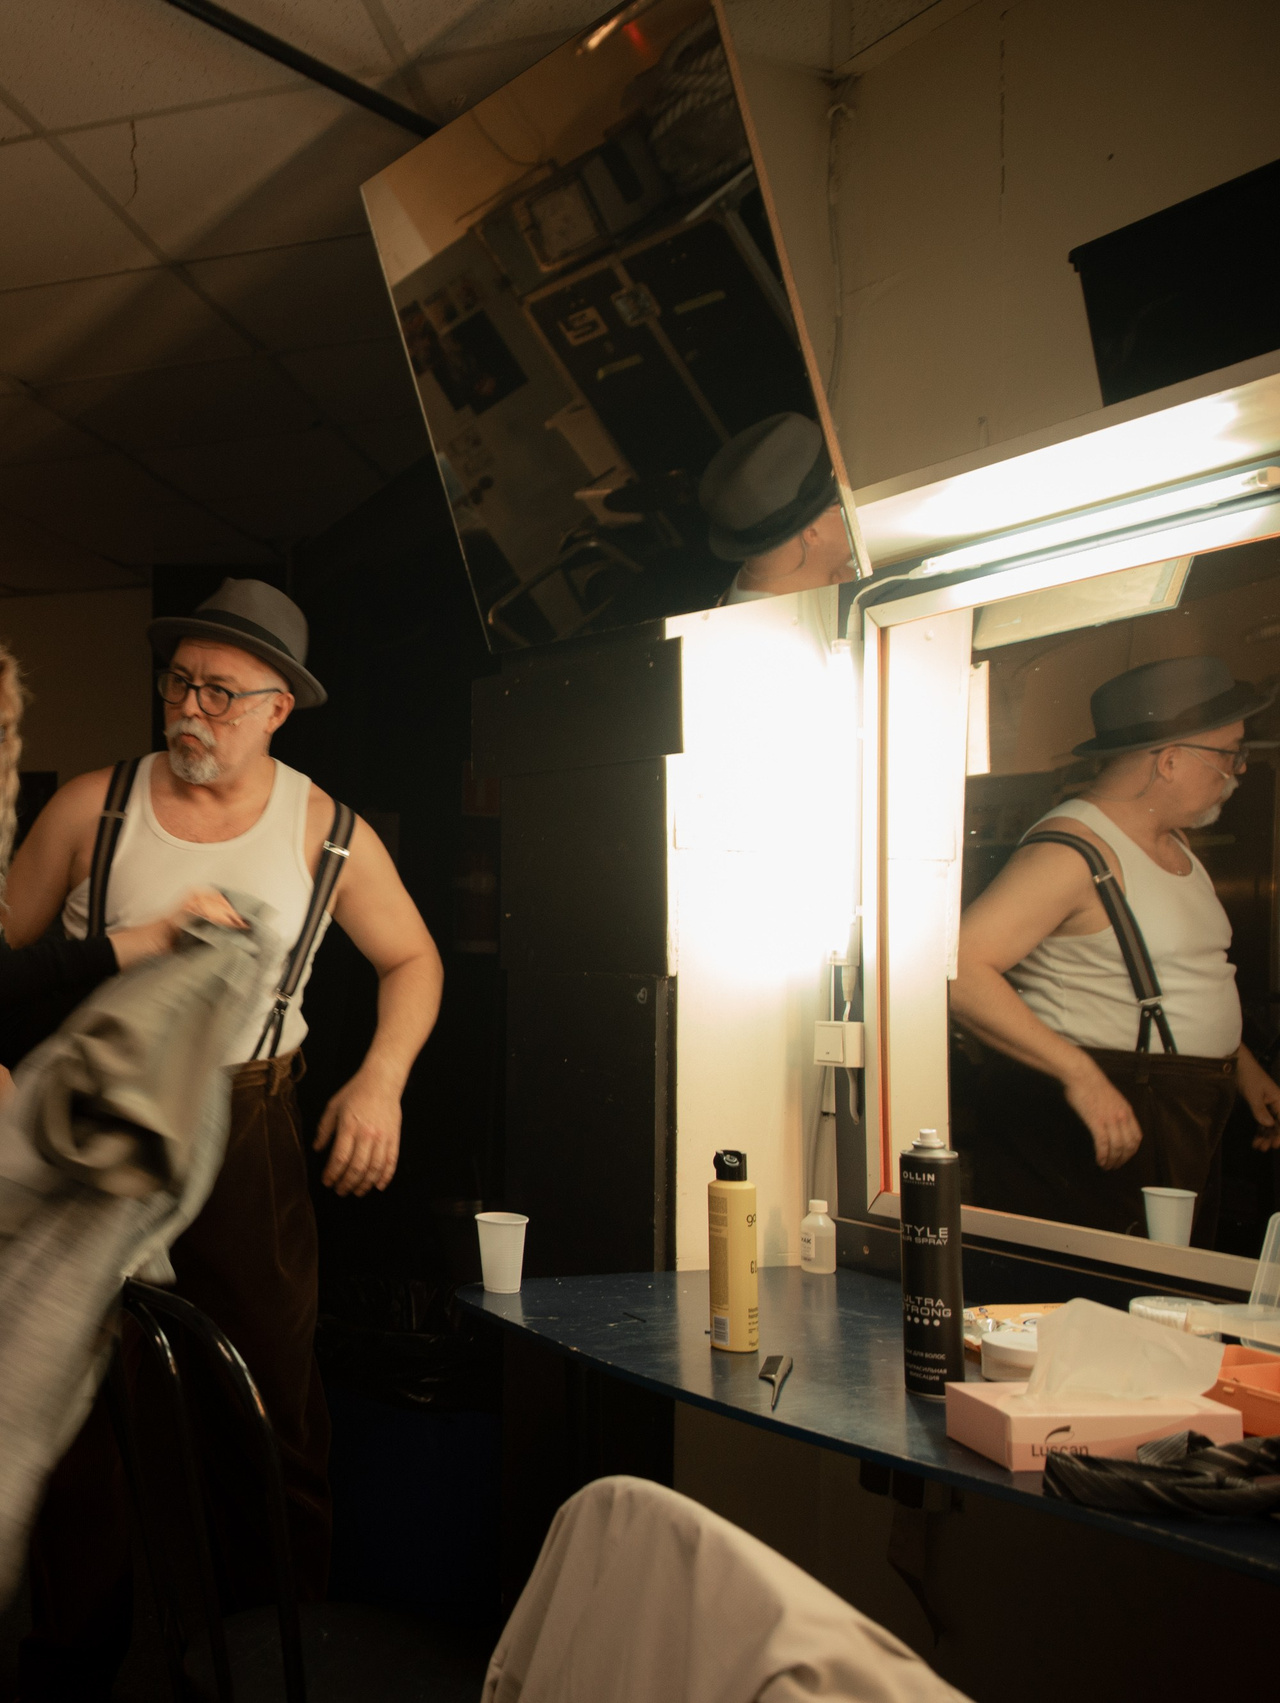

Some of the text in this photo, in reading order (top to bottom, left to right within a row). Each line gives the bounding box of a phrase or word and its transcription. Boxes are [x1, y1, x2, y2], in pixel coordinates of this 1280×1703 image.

[903, 1170, 935, 1182] OLLIN
[915, 1236, 948, 1246] SPRAY
[903, 1303, 952, 1317] TRONG
